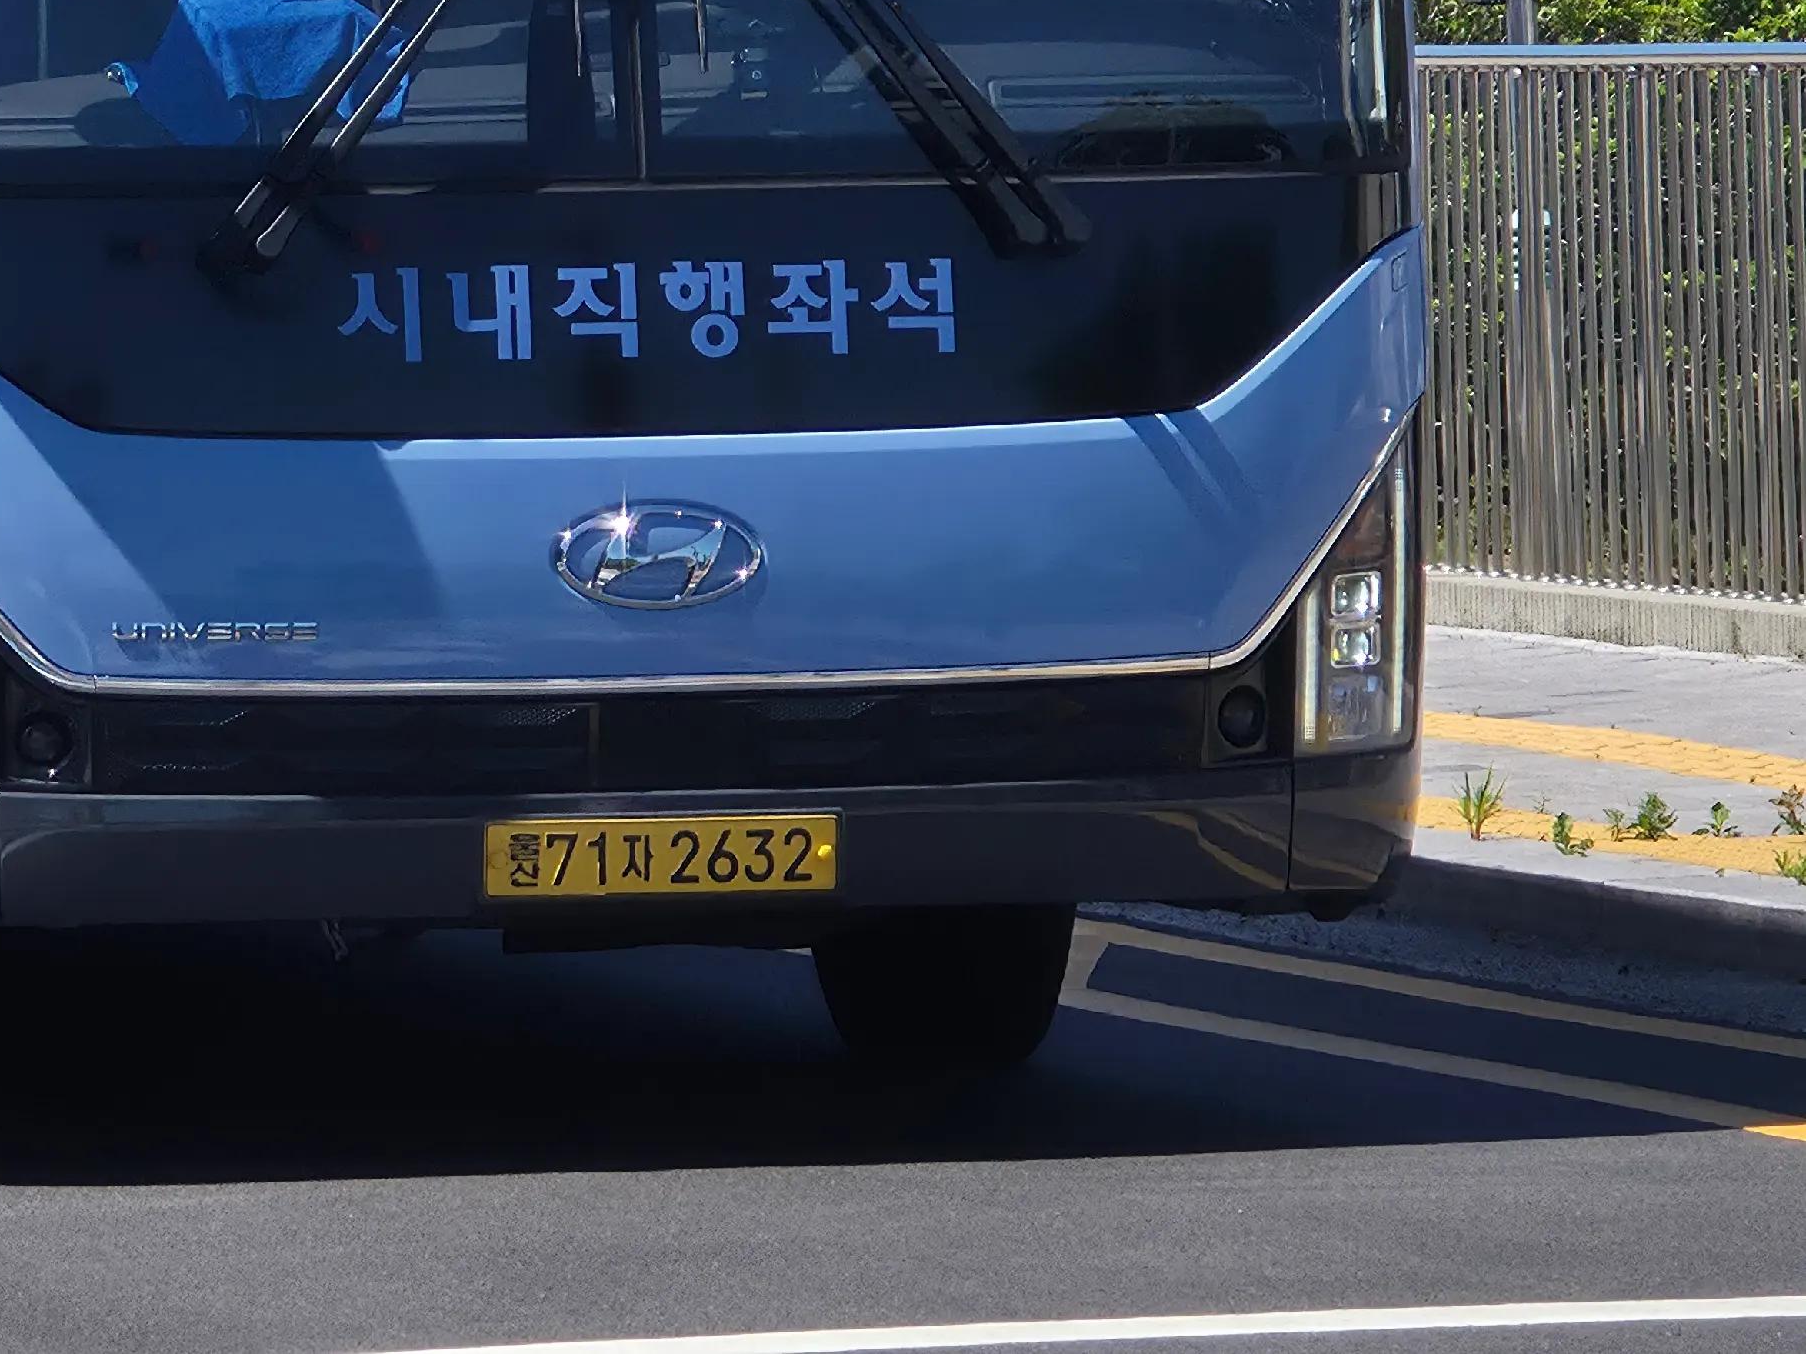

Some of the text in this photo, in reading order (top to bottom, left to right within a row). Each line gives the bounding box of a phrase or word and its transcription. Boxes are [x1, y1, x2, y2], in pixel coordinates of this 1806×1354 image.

[337, 257, 957, 363] 시내직행좌석
[111, 621, 319, 641] UNIVERSE
[670, 826, 813, 884] 2632
